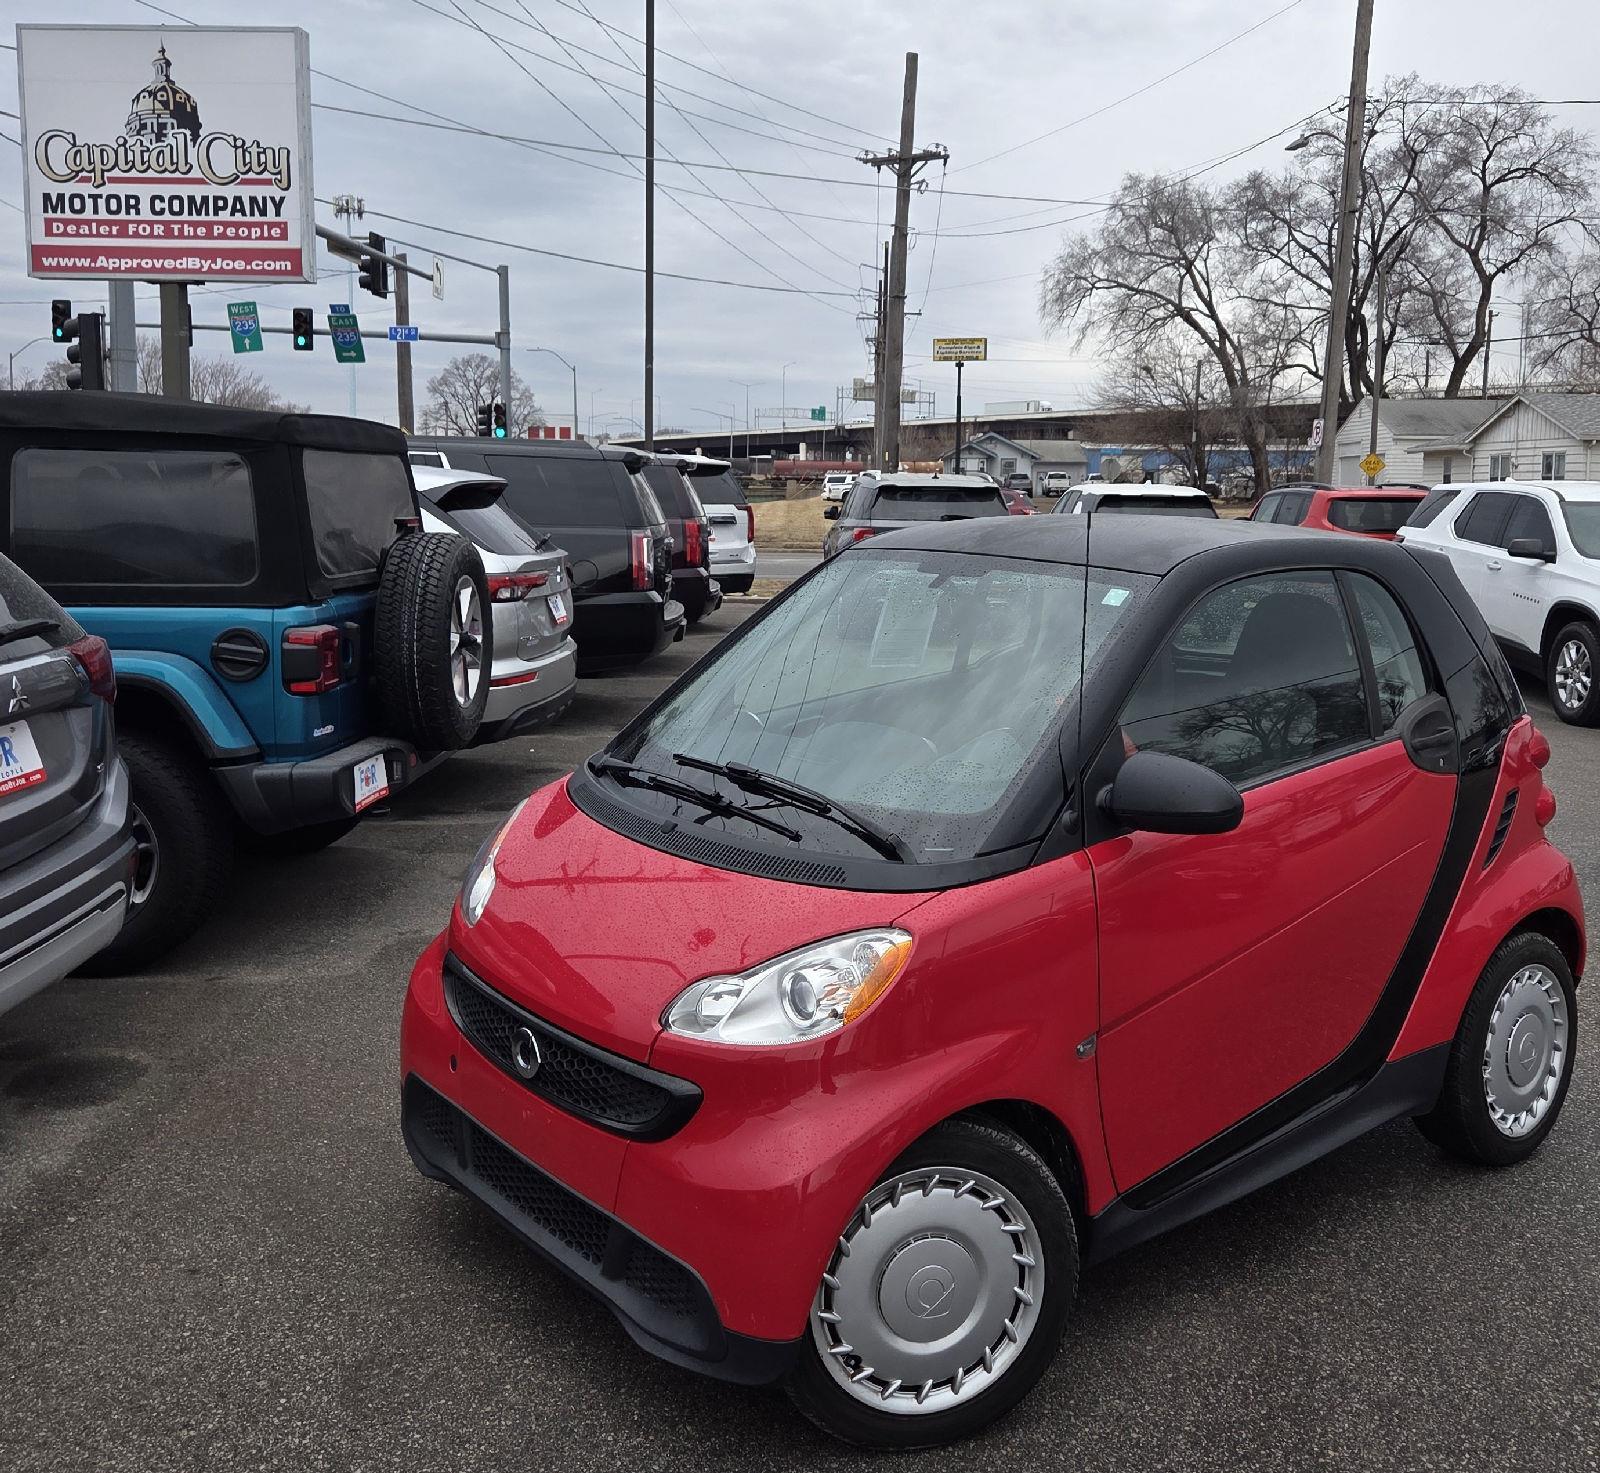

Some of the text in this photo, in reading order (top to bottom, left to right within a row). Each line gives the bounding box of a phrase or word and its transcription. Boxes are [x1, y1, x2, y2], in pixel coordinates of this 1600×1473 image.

[35, 129, 291, 191] Capital City
[42, 193, 286, 217] MOTOR COMPANY
[52, 222, 281, 239] Dealer FOR The People
[41, 255, 292, 272] www.ApprovedByJoe.com
[230, 304, 254, 314] WEST
[235, 319, 256, 331] 235
[331, 317, 354, 326] EAST
[337, 332, 357, 342] 235
